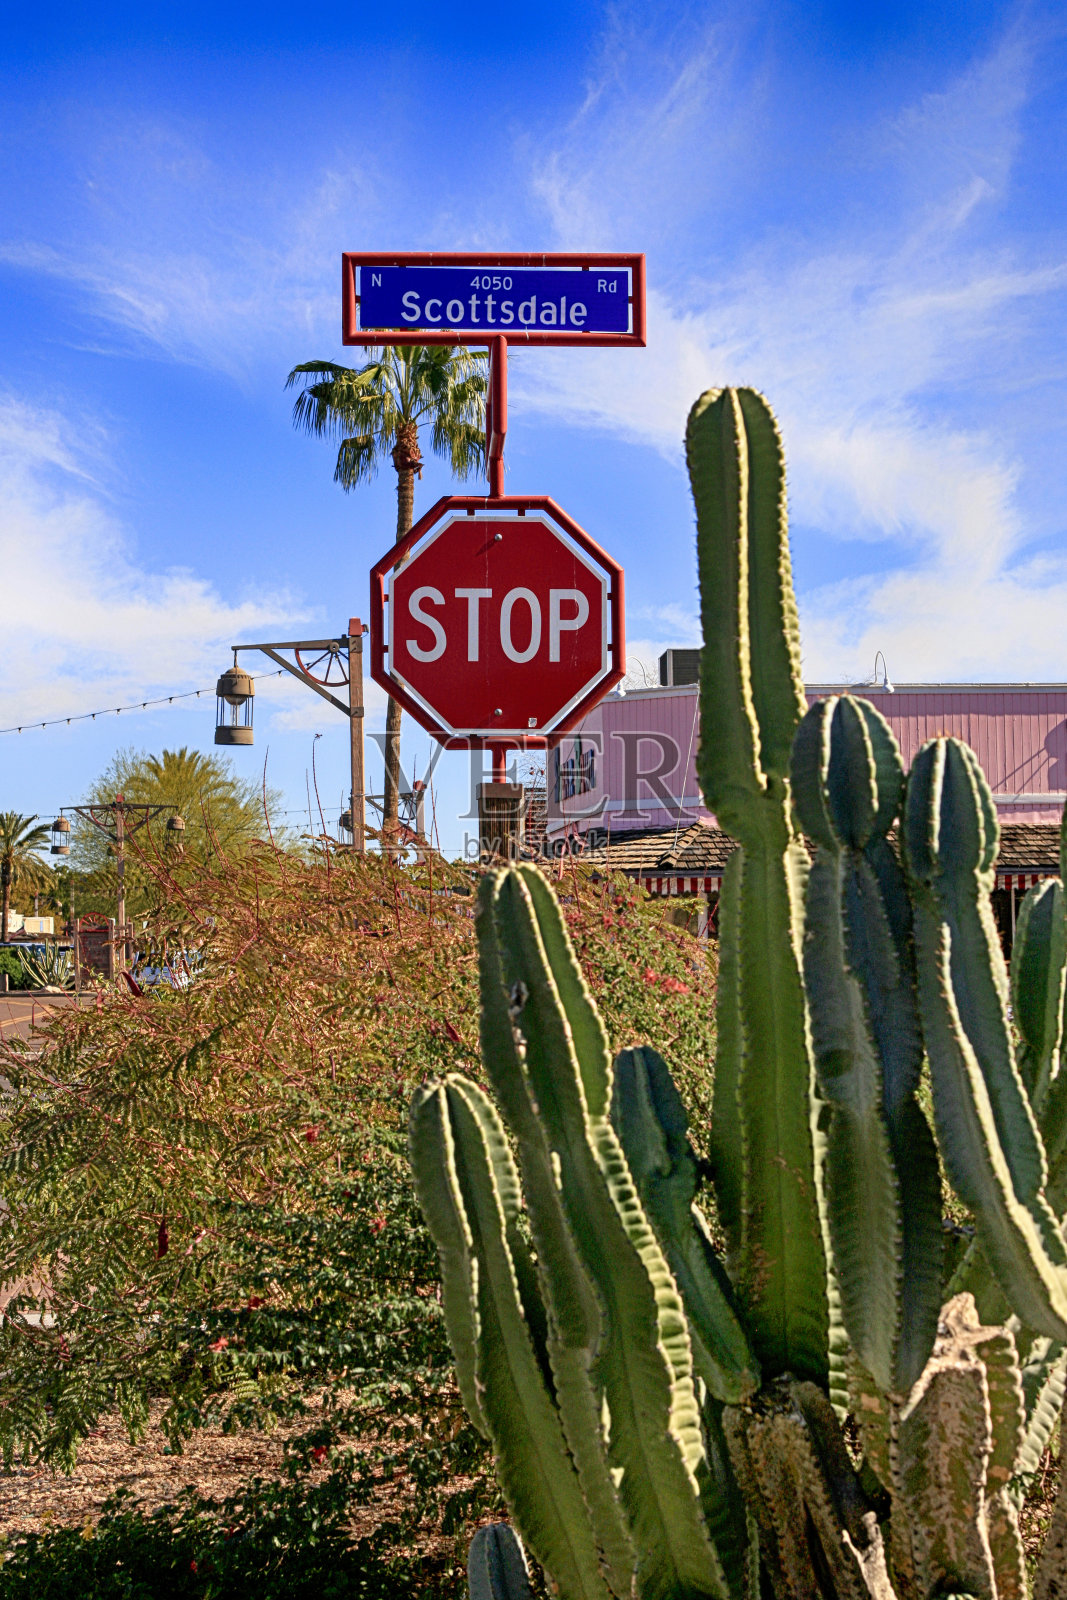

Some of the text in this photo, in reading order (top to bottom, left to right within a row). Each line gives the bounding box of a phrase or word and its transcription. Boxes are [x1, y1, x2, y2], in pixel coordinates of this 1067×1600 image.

[371, 273, 617, 293] N 4050 Rd
[400, 290, 588, 326] Scottsdale
[405, 586, 590, 664] STOP
